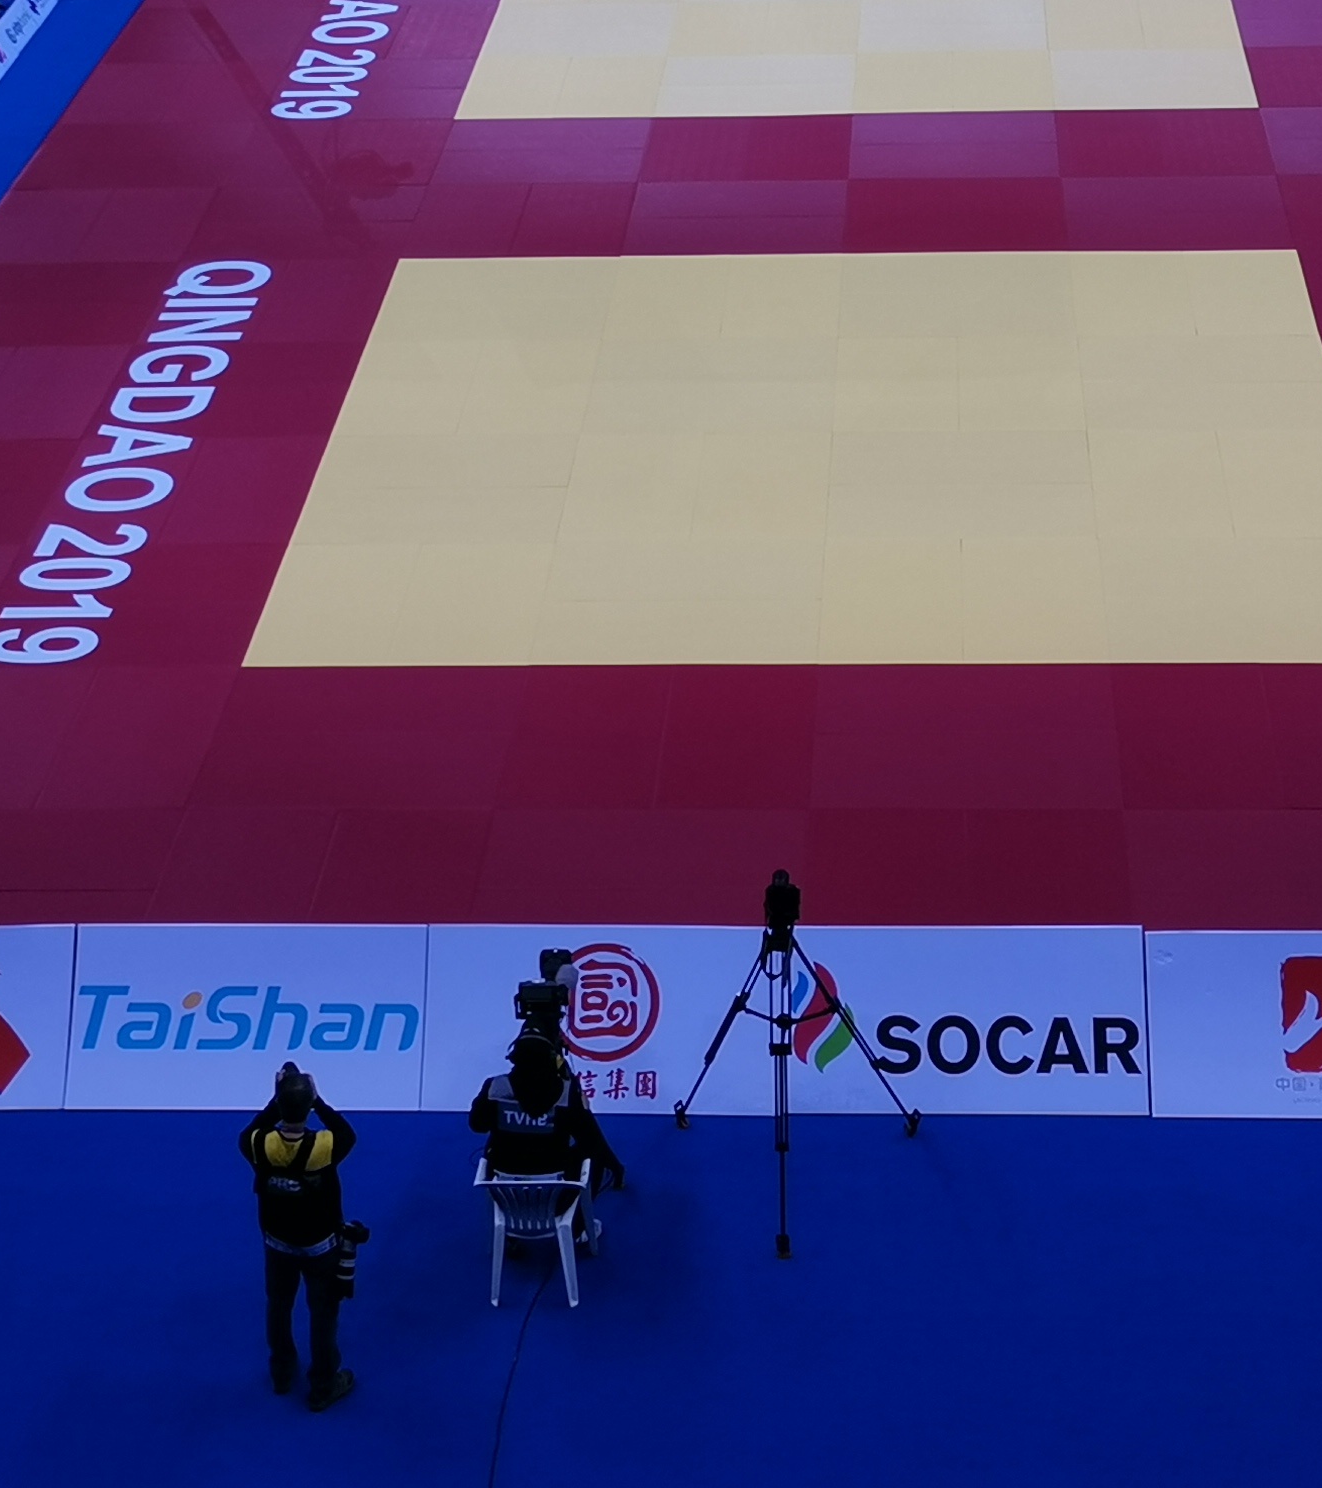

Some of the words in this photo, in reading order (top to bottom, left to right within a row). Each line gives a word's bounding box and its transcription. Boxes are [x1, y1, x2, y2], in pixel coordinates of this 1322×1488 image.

[270, 48, 376, 120] 2019
[64, 260, 272, 512] QINGDAO
[77, 985, 421, 1055] TaiShan
[877, 1014, 1143, 1077] SOCAR
